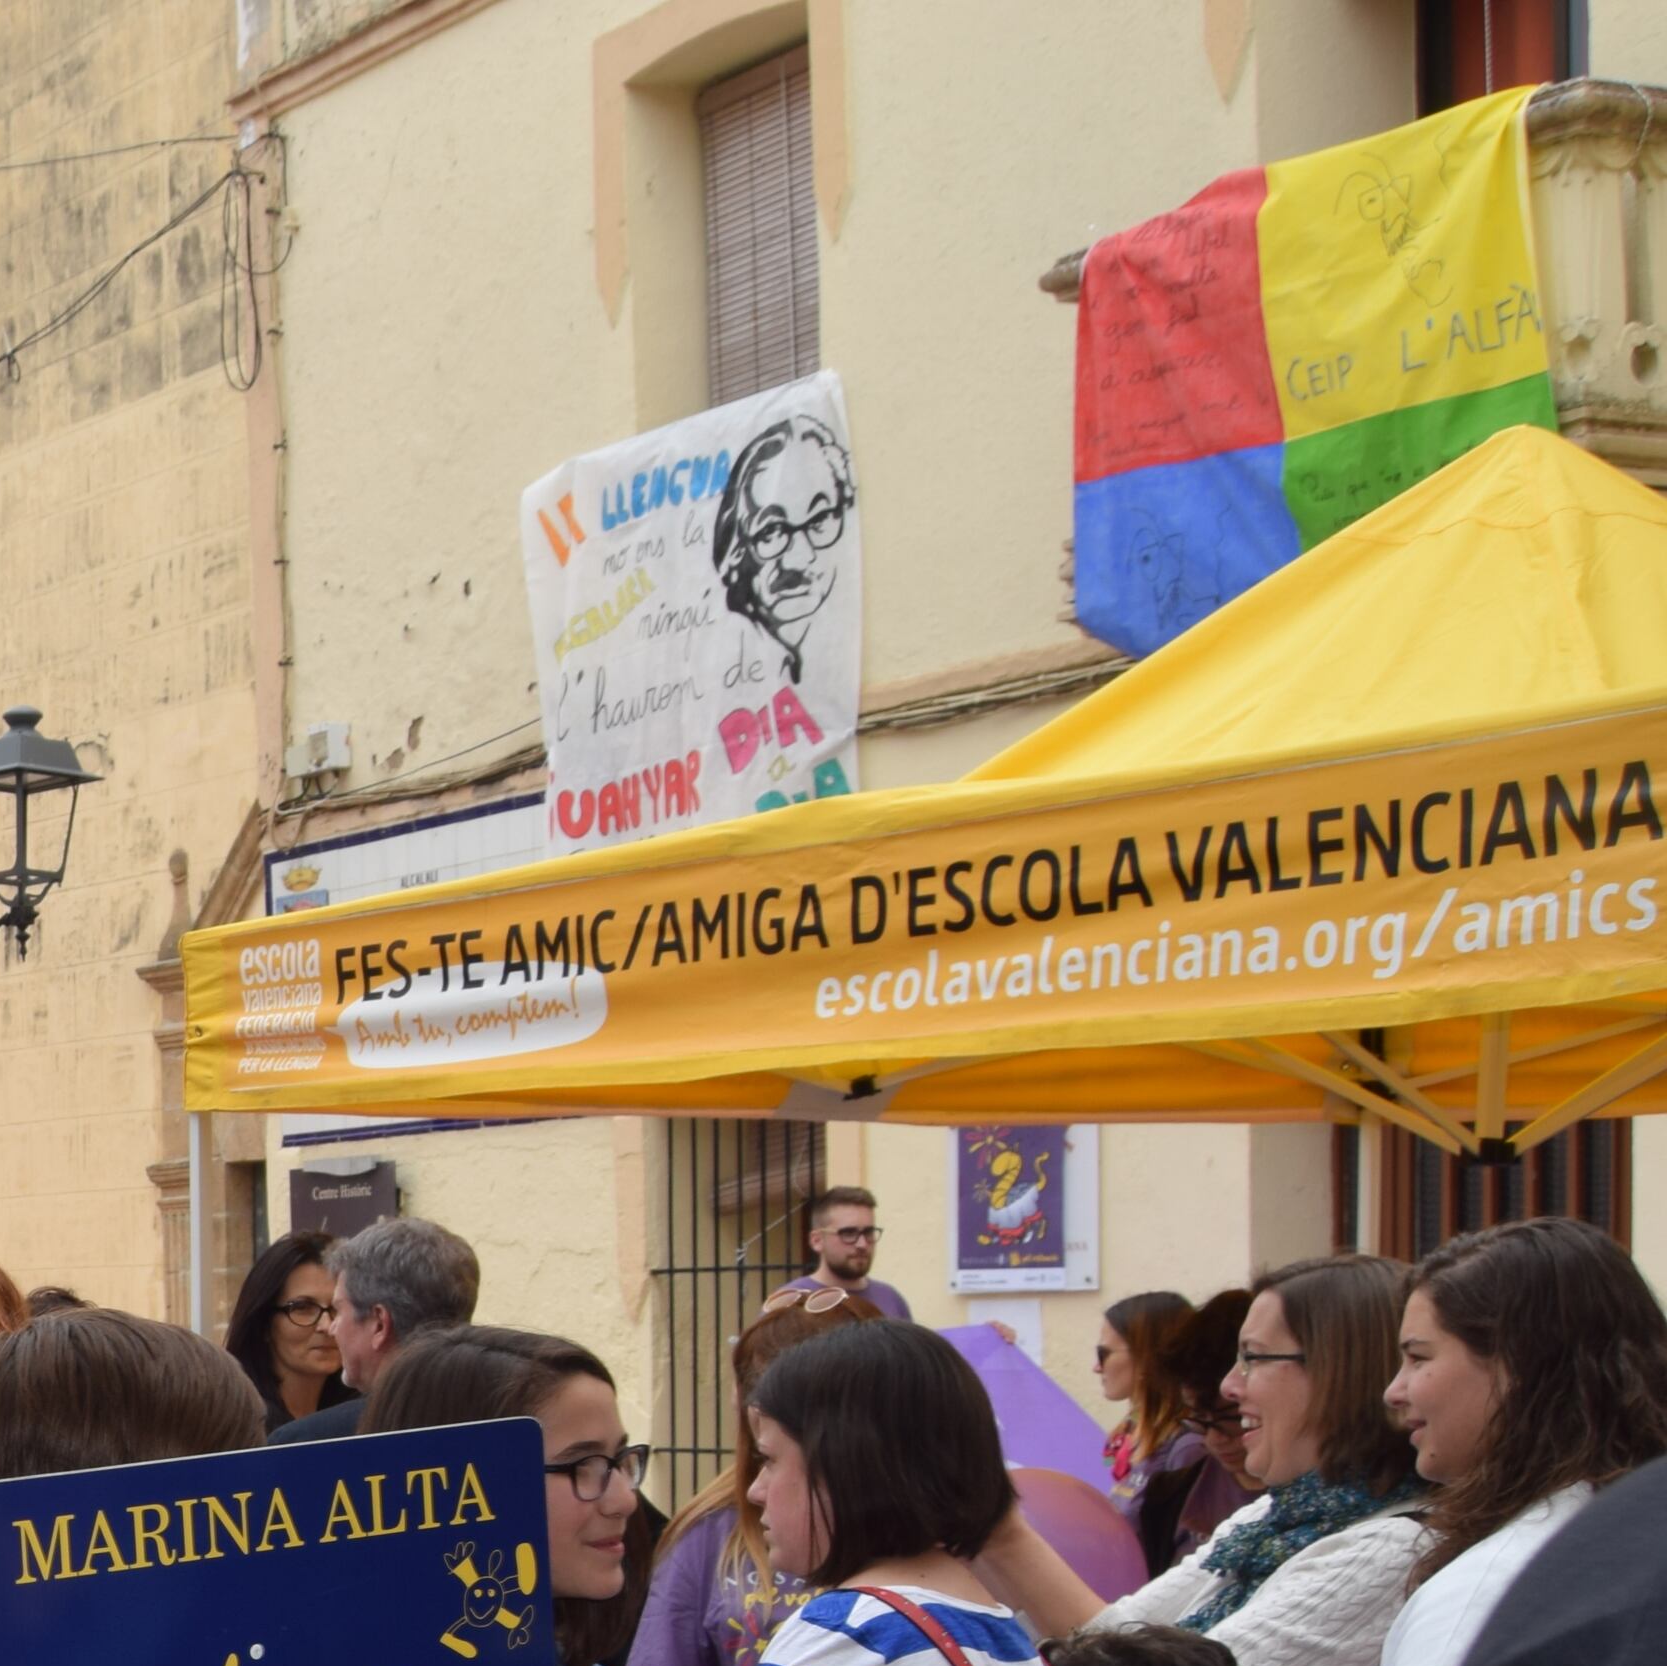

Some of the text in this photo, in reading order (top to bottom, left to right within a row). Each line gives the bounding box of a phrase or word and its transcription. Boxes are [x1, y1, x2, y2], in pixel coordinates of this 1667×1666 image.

[1286, 353, 1353, 402] CEIP
[723, 633, 765, 688] de
[550, 750, 700, 840] UANYAR
[718, 686, 824, 774] DIA
[335, 760, 1664, 1005] FES-TE AMIC/AMIGA D'ESCOLA VALENCIANA
[240, 938, 321, 985] escola
[816, 870, 1656, 1019] escolavalenciana.org/amics
[242, 983, 322, 1012] valenciana
[312, 1185, 338, 1201] Centre
[12, 1463, 495, 1586] MARINA ALTA
